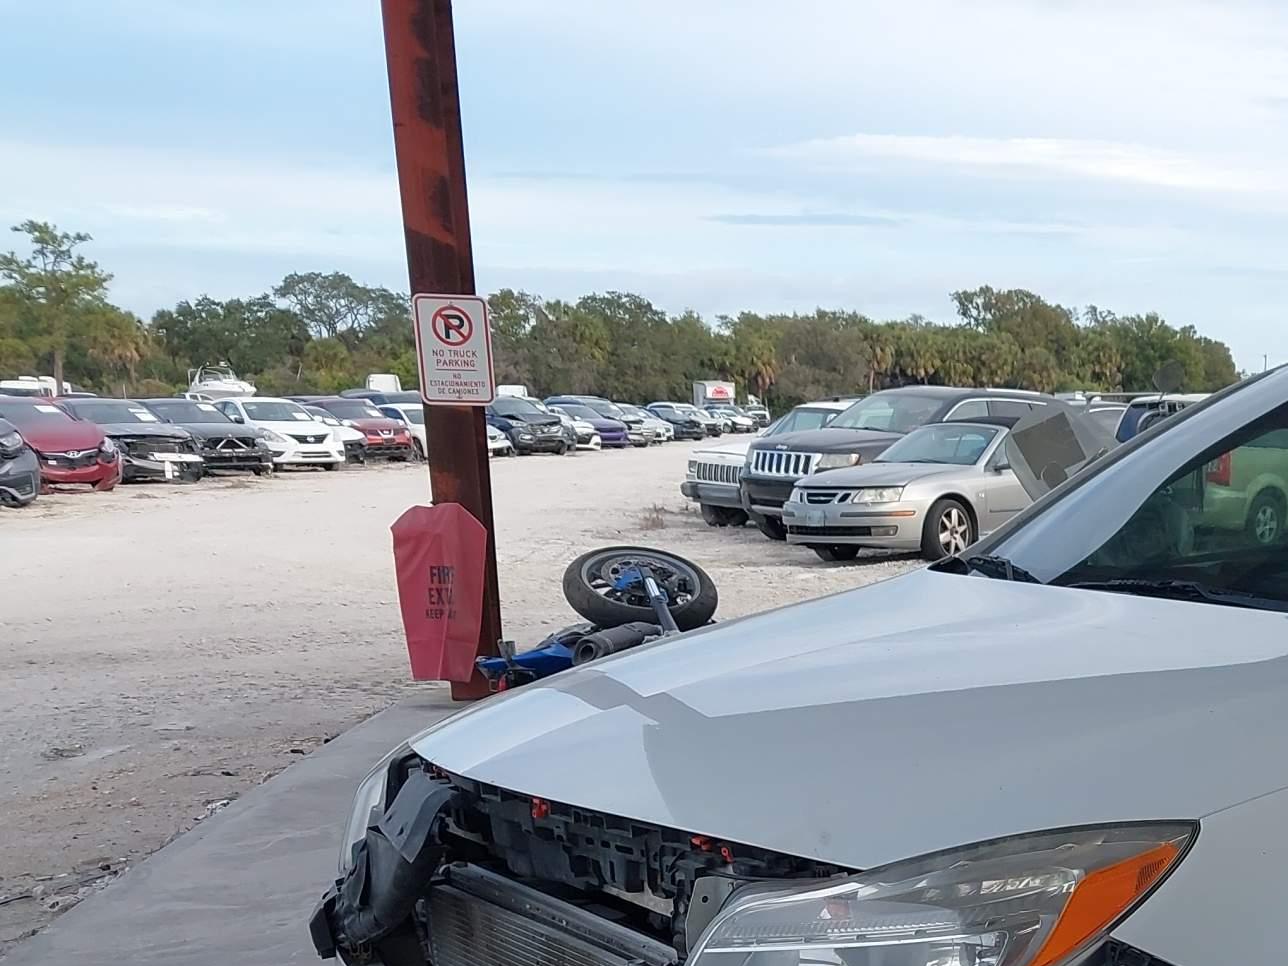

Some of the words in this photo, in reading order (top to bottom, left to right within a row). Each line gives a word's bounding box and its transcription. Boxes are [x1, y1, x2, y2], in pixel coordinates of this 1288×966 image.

[432, 349, 445, 357] NO
[448, 350, 478, 358] TRUCK
[436, 359, 476, 368] PARKING
